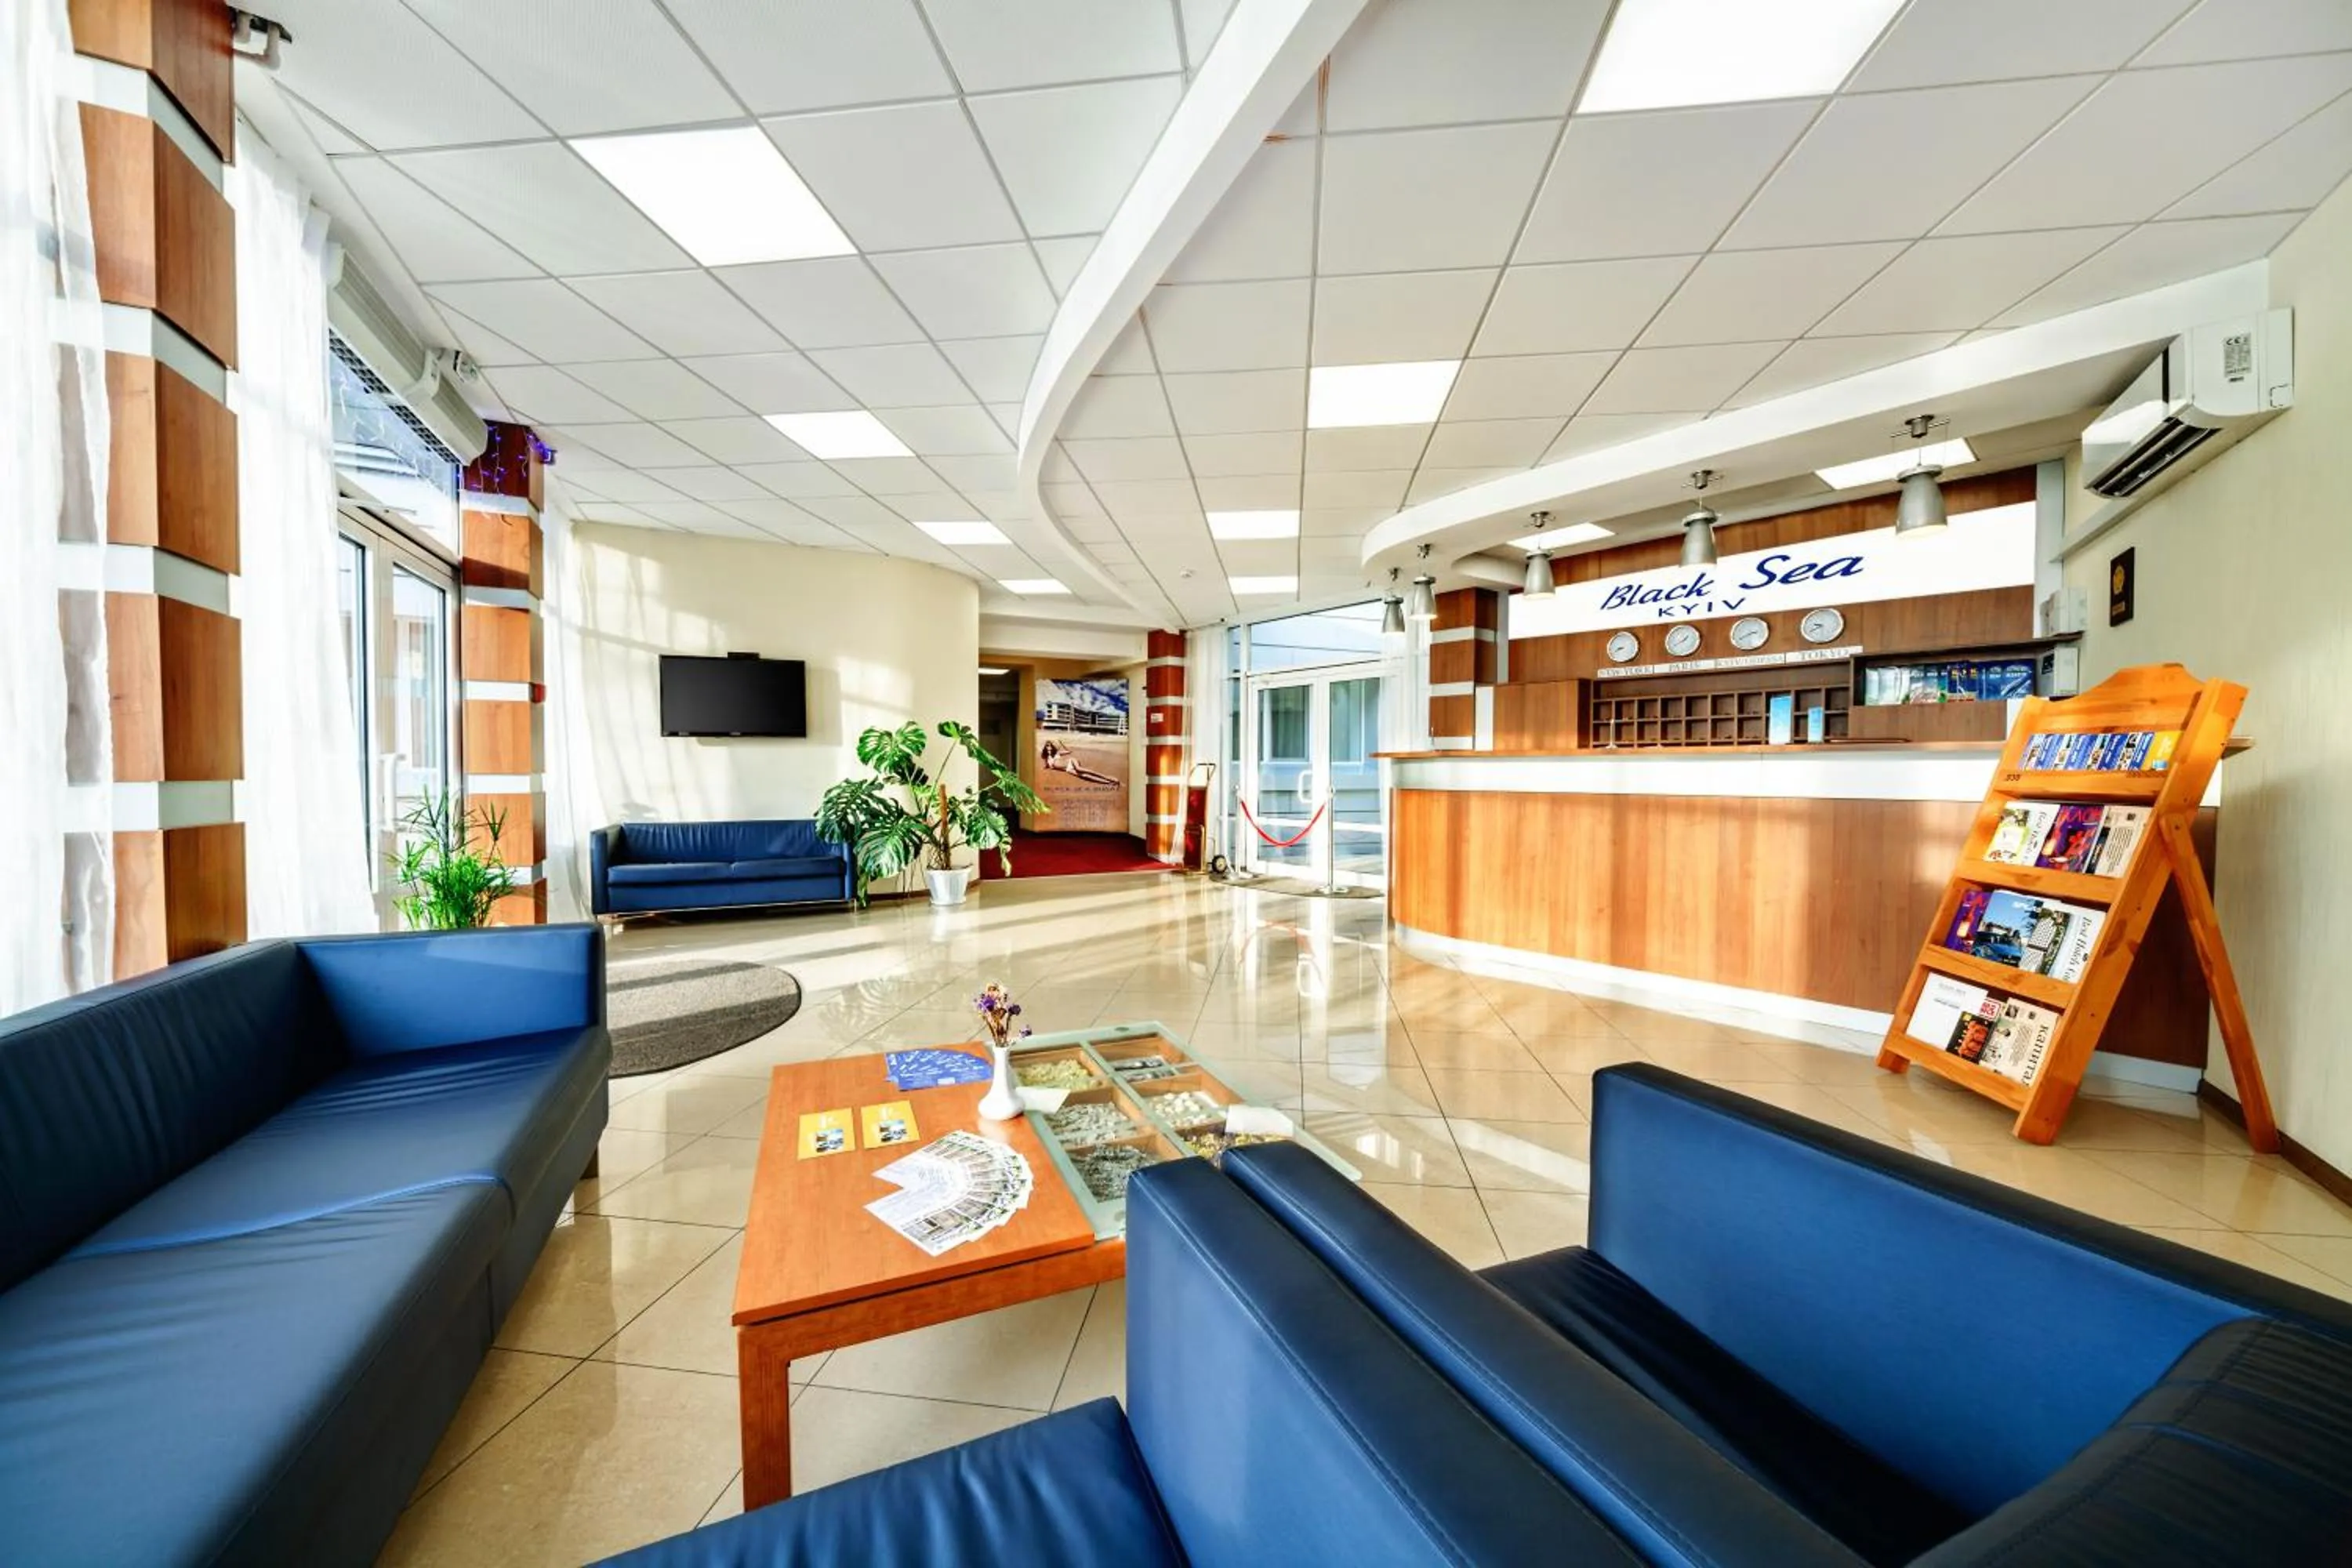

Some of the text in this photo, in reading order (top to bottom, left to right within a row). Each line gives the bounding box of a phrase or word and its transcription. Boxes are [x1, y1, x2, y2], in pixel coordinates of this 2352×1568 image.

[1600, 554, 1864, 610] Black Sea
[1657, 597, 1746, 618] KYIV
[1802, 649, 1849, 661] TOKYO
